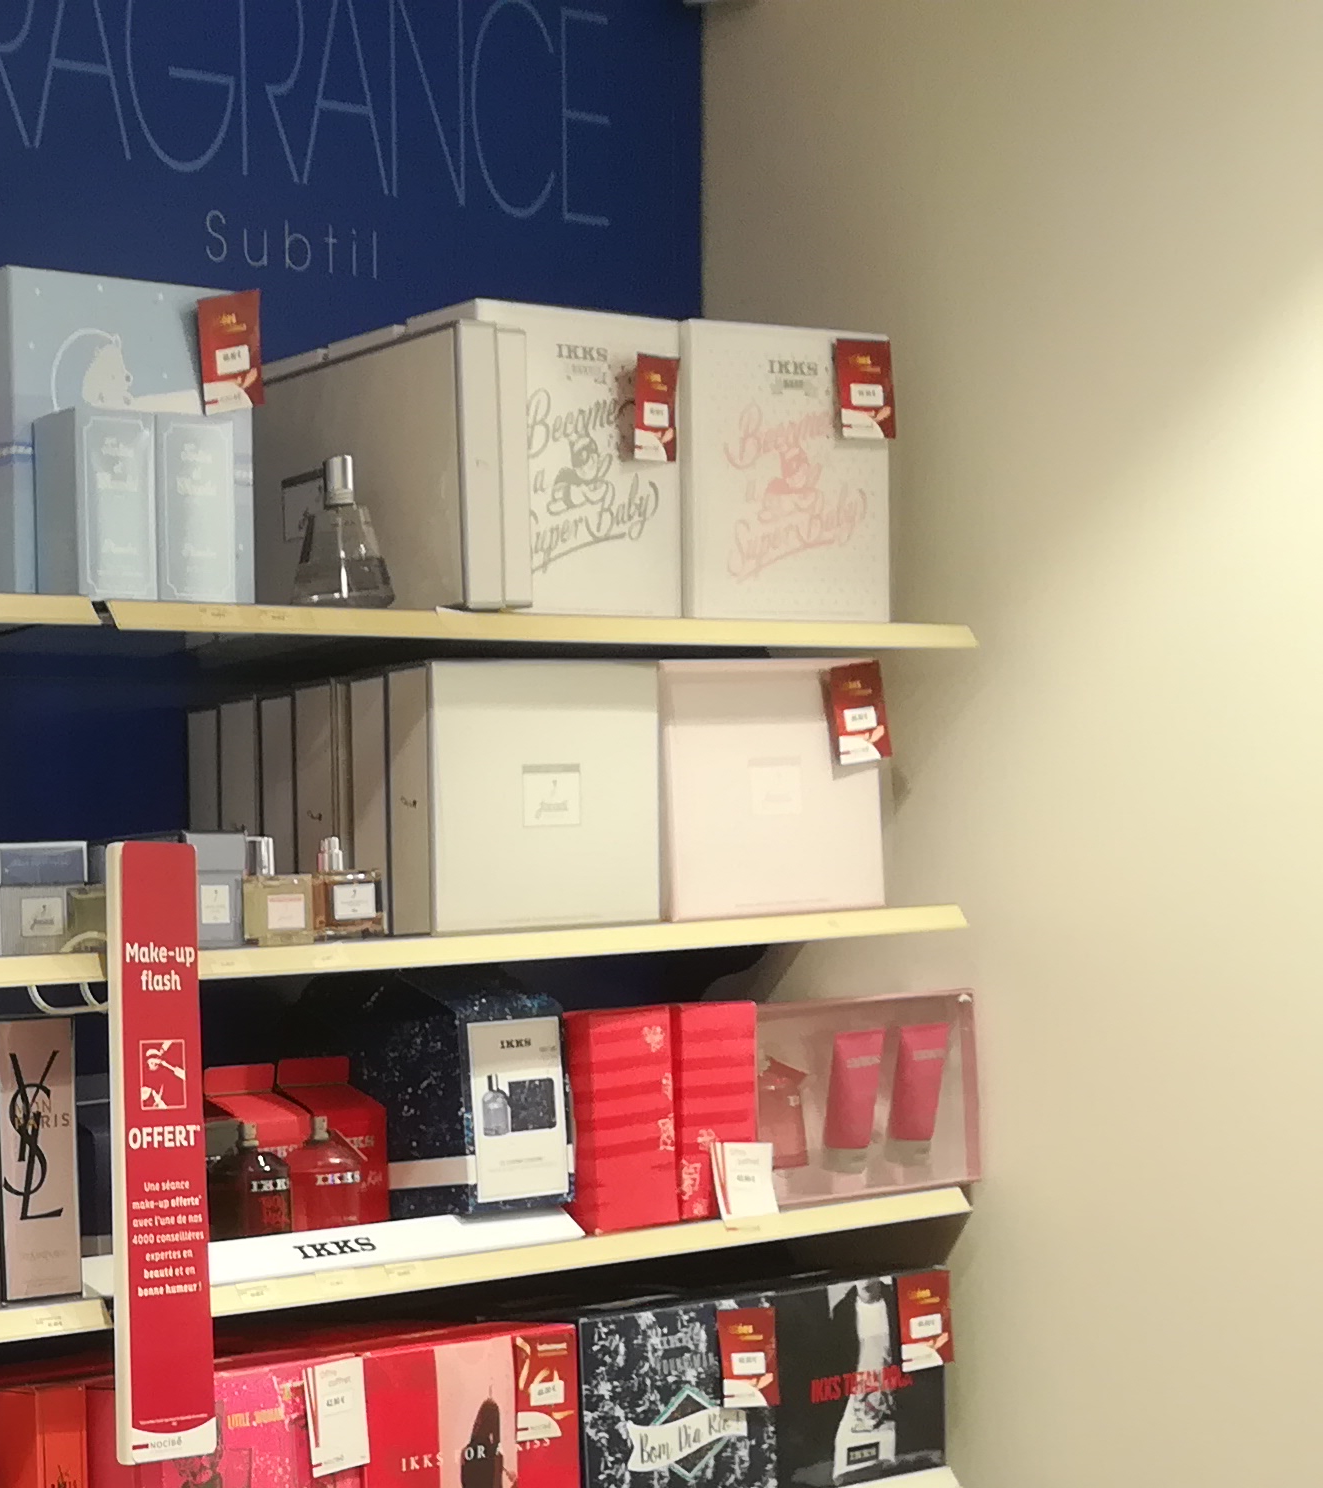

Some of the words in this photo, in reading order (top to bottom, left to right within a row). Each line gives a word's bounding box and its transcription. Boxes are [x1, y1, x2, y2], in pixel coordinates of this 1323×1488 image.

[205, 209, 379, 279] Subtil
[556, 344, 607, 362] IKKS
[768, 360, 818, 376] IKKS
[125, 942, 196, 968] Make-up
[140, 969, 182, 992] flash
[499, 1037, 532, 1051] IKKS
[144, 1181, 161, 1192] Une
[177, 1214, 186, 1225] de
[293, 1236, 377, 1261] IKKS
[401, 1453, 444, 1472] IKKS
